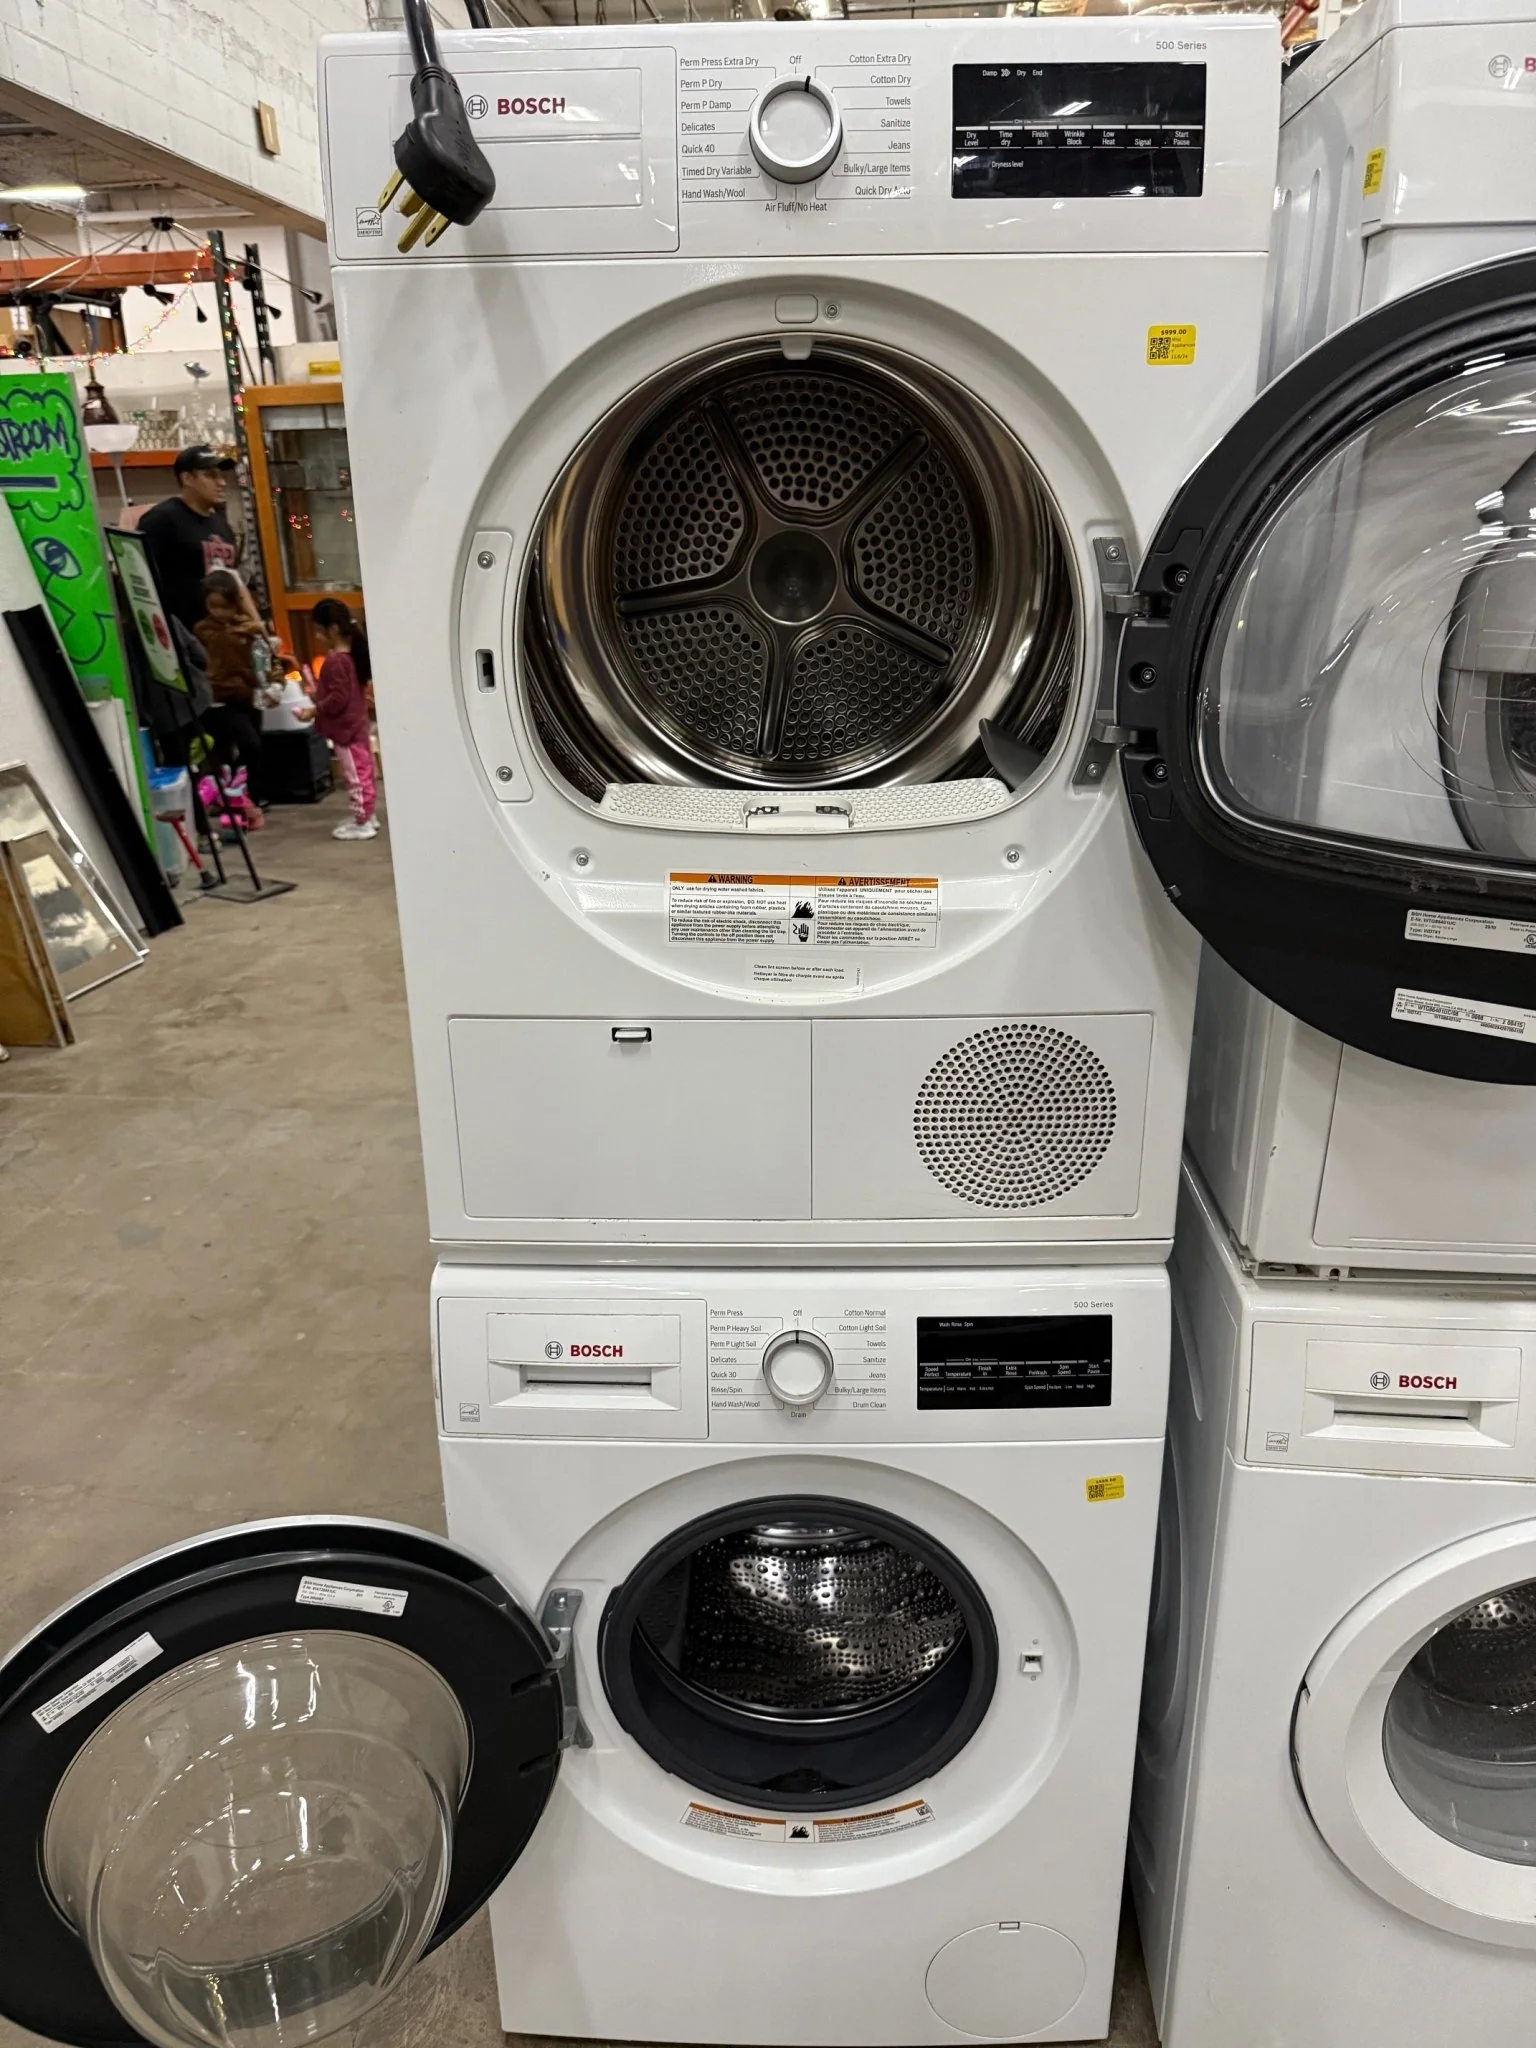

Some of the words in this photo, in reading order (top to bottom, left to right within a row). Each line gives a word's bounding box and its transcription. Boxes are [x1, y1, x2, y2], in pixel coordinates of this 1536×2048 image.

[1156, 41, 1174, 50] 500
[1178, 41, 1206, 50] Series
[745, 58, 758, 66] Dry
[790, 55, 802, 64] Off
[898, 55, 911, 64] Dry
[1017, 69, 1026, 77] Dry
[680, 79, 700, 87] Perm
[702, 79, 707, 87] P
[709, 79, 722, 89] Dry
[870, 75, 896, 83] Cotton
[897, 75, 911, 85] Dry
[681, 101, 701, 109] Perm
[702, 101, 707, 109] P
[709, 101, 731, 110] Damp
[885, 97, 911, 105] Towels
[497, 97, 566, 115] BOSCH
[681, 122, 715, 131] Delicates
[881, 119, 911, 127] Sanitize
[1103, 130, 1114, 138] Low
[1175, 130, 1189, 138] Start
[888, 141, 911, 150] Jeans
[1135, 138, 1151, 146] Signal
[1173, 138, 1190, 146] Pause
[682, 144, 703, 154] Quick
[705, 144, 714, 152] 40
[682, 167, 705, 175] Timed
[707, 166, 720, 176] Dry
[722, 166, 751, 175] Variable
[844, 164, 888, 174] Bulky/Large
[890, 164, 910, 172] Items
[682, 189, 702, 197] Hand
[703, 189, 745, 198] Wash/Wool
[855, 186, 877, 195] Quick
[878, 186, 892, 195] Dry
[765, 203, 775, 211] Air
[777, 203, 808, 212] Fluff/No
[809, 203, 827, 211] Heat
[719, 874, 753, 884] WARNING
[849, 877, 910, 887] AVERTISSEMENT
[570, 1345, 623, 1357] BOSCH
[1399, 1375, 1457, 1390] BOSCH
